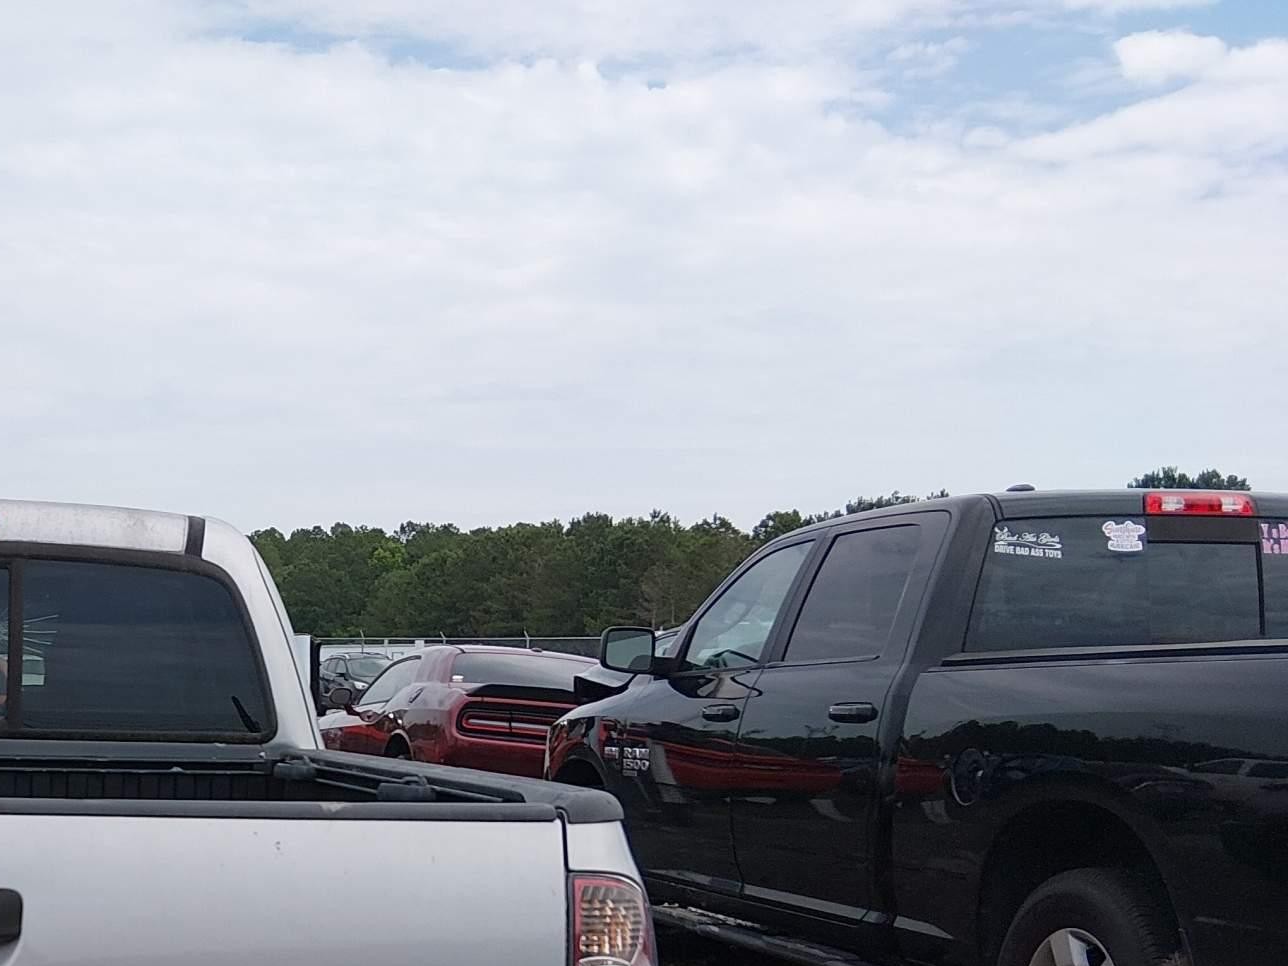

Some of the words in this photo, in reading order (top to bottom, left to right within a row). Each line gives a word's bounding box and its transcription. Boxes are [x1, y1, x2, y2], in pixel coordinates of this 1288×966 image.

[994, 544, 1015, 554] DRIVE
[1015, 546, 1030, 556] BAD
[1030, 548, 1044, 557] ASS
[1044, 549, 1062, 559] TOYS
[623, 747, 649, 758] RAM
